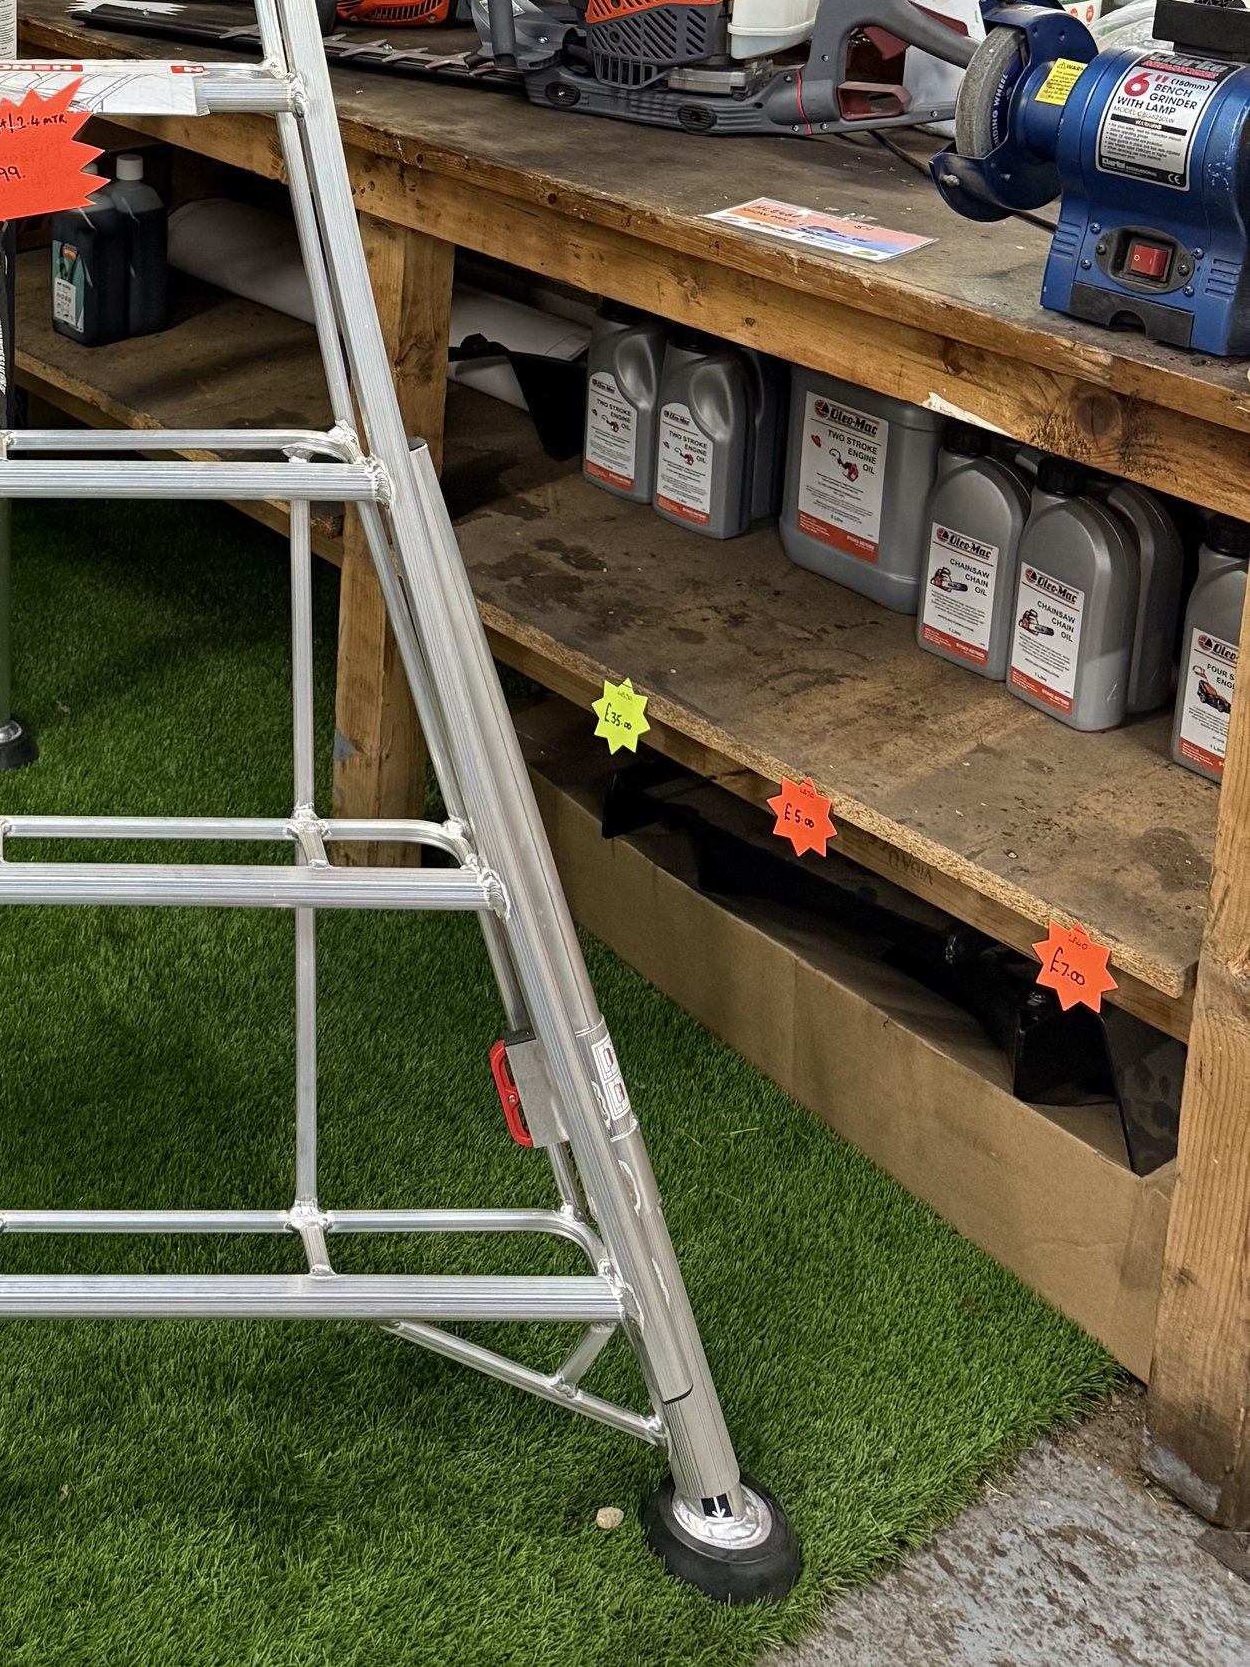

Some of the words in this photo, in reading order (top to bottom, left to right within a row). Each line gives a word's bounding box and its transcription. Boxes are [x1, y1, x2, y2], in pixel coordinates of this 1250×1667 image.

[1150, 53, 1227, 73] Clarke
[993, 74, 1008, 106] WHEEL
[1153, 84, 1193, 98] BENCH
[1170, 77, 1210, 92] (150mm)
[1117, 96, 1144, 109] WITH
[1145, 102, 1176, 116] LAMP
[1149, 92, 1198, 110] GRINDER
[597, 398, 609, 408] TWO
[609, 404, 632, 417] STROKE
[610, 412, 632, 424] ENGINE
[621, 423, 632, 431] OIL
[830, 408, 879, 435] Oleo-Mac
[669, 430, 682, 441] TWO
[682, 435, 708, 449] STROKE
[828, 429, 845, 442] TWO
[846, 437, 878, 455] STROKE
[684, 444, 708, 457] ENGINE
[696, 455, 707, 464] OIL
[847, 448, 877, 465] ENGINE
[862, 463, 875, 475] OIL
[949, 534, 992, 559] Oleo-Mac
[949, 558, 990, 579] CHAINSAW
[965, 573, 989, 588] CHAIN
[1037, 576, 1078, 603] Oleo-Mac
[975, 586, 987, 596] OIL
[1037, 600, 1076, 624] CHAINSAW
[1051, 617, 1074, 633] CHAIN
[1060, 631, 1073, 642] OIL
[1207, 663, 1228, 678] FOUR
[605, 702, 632, 730] £35.00
[784, 802, 815, 829] £5.00
[1050, 946, 1085, 985] £7.00
